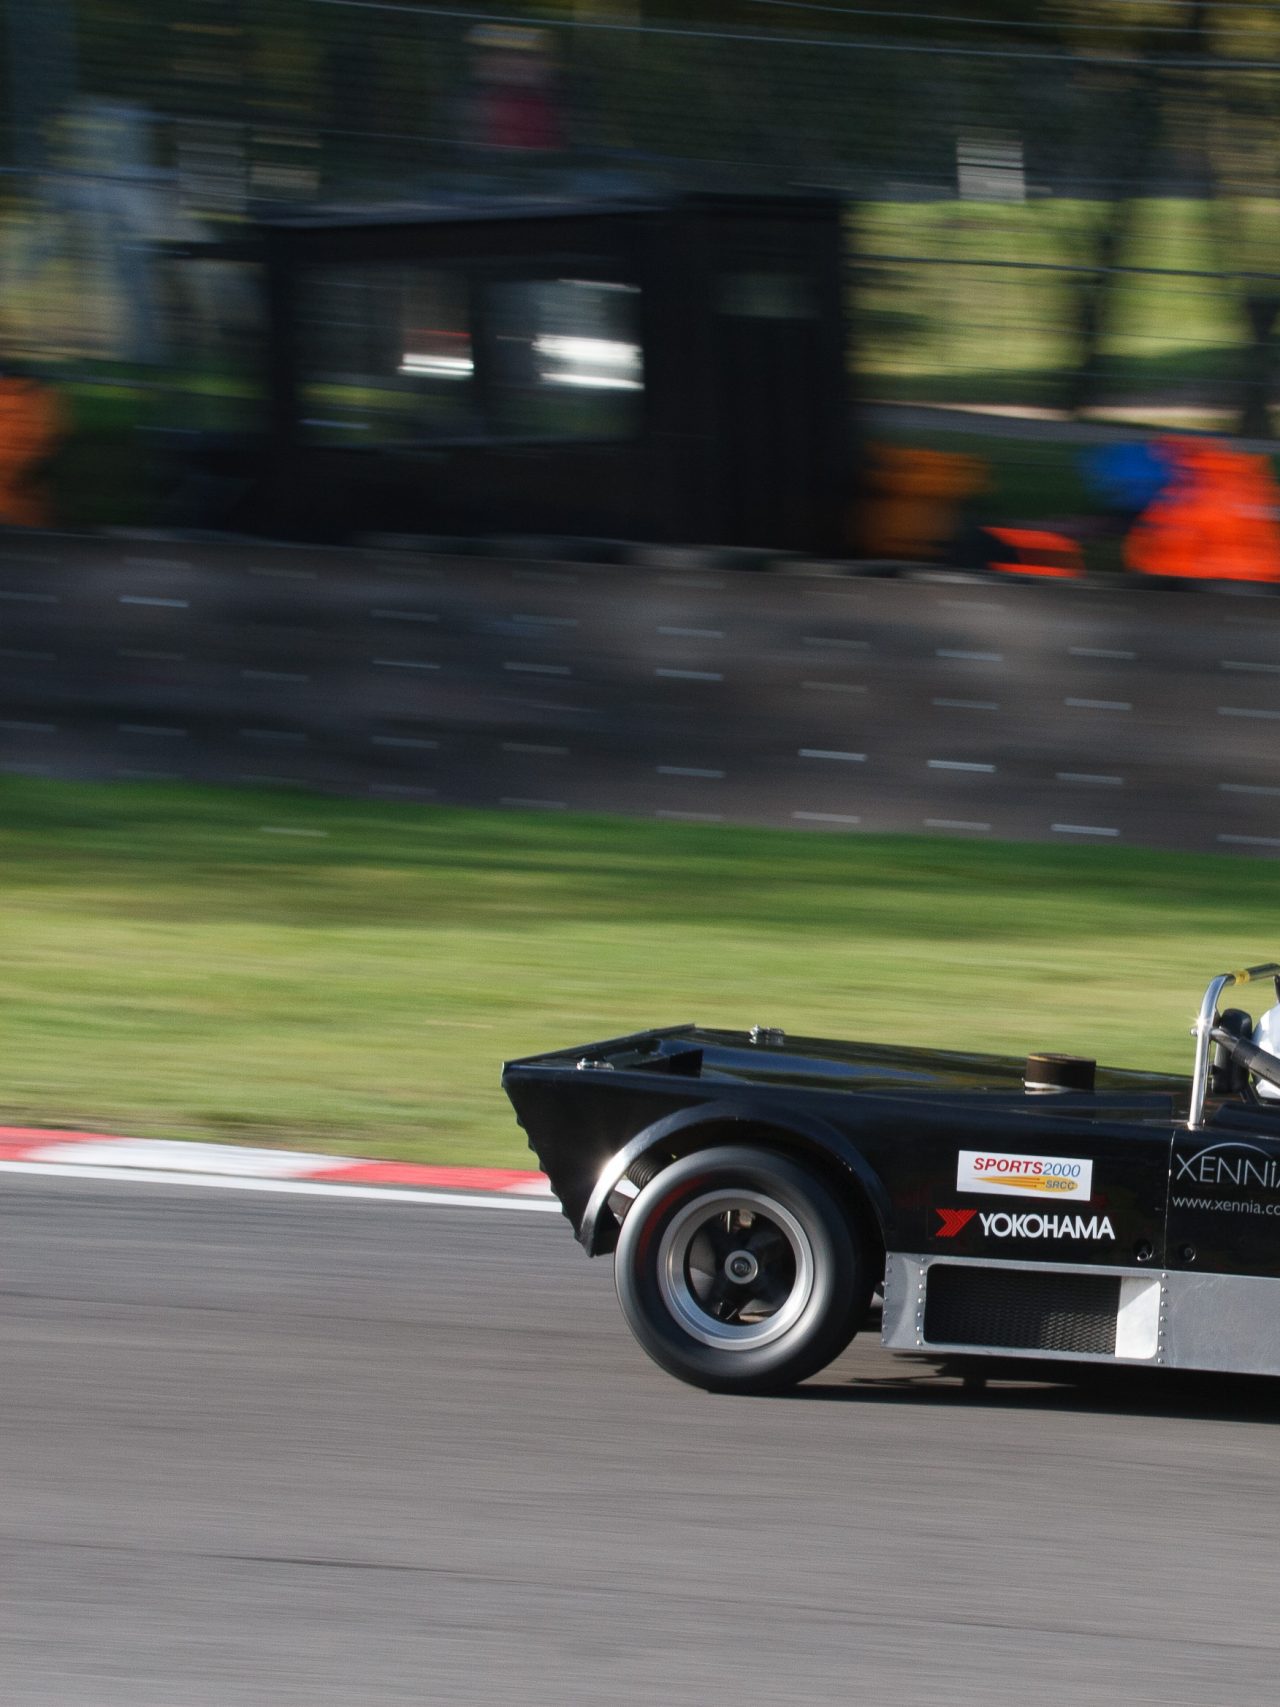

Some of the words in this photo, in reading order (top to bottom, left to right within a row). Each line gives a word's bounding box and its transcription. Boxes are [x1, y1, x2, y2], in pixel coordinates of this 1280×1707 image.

[973, 1157, 1081, 1178] SPORTS2000
[1045, 1180, 1077, 1190] SRCC
[979, 1212, 1115, 1240] YOKOHAMA
